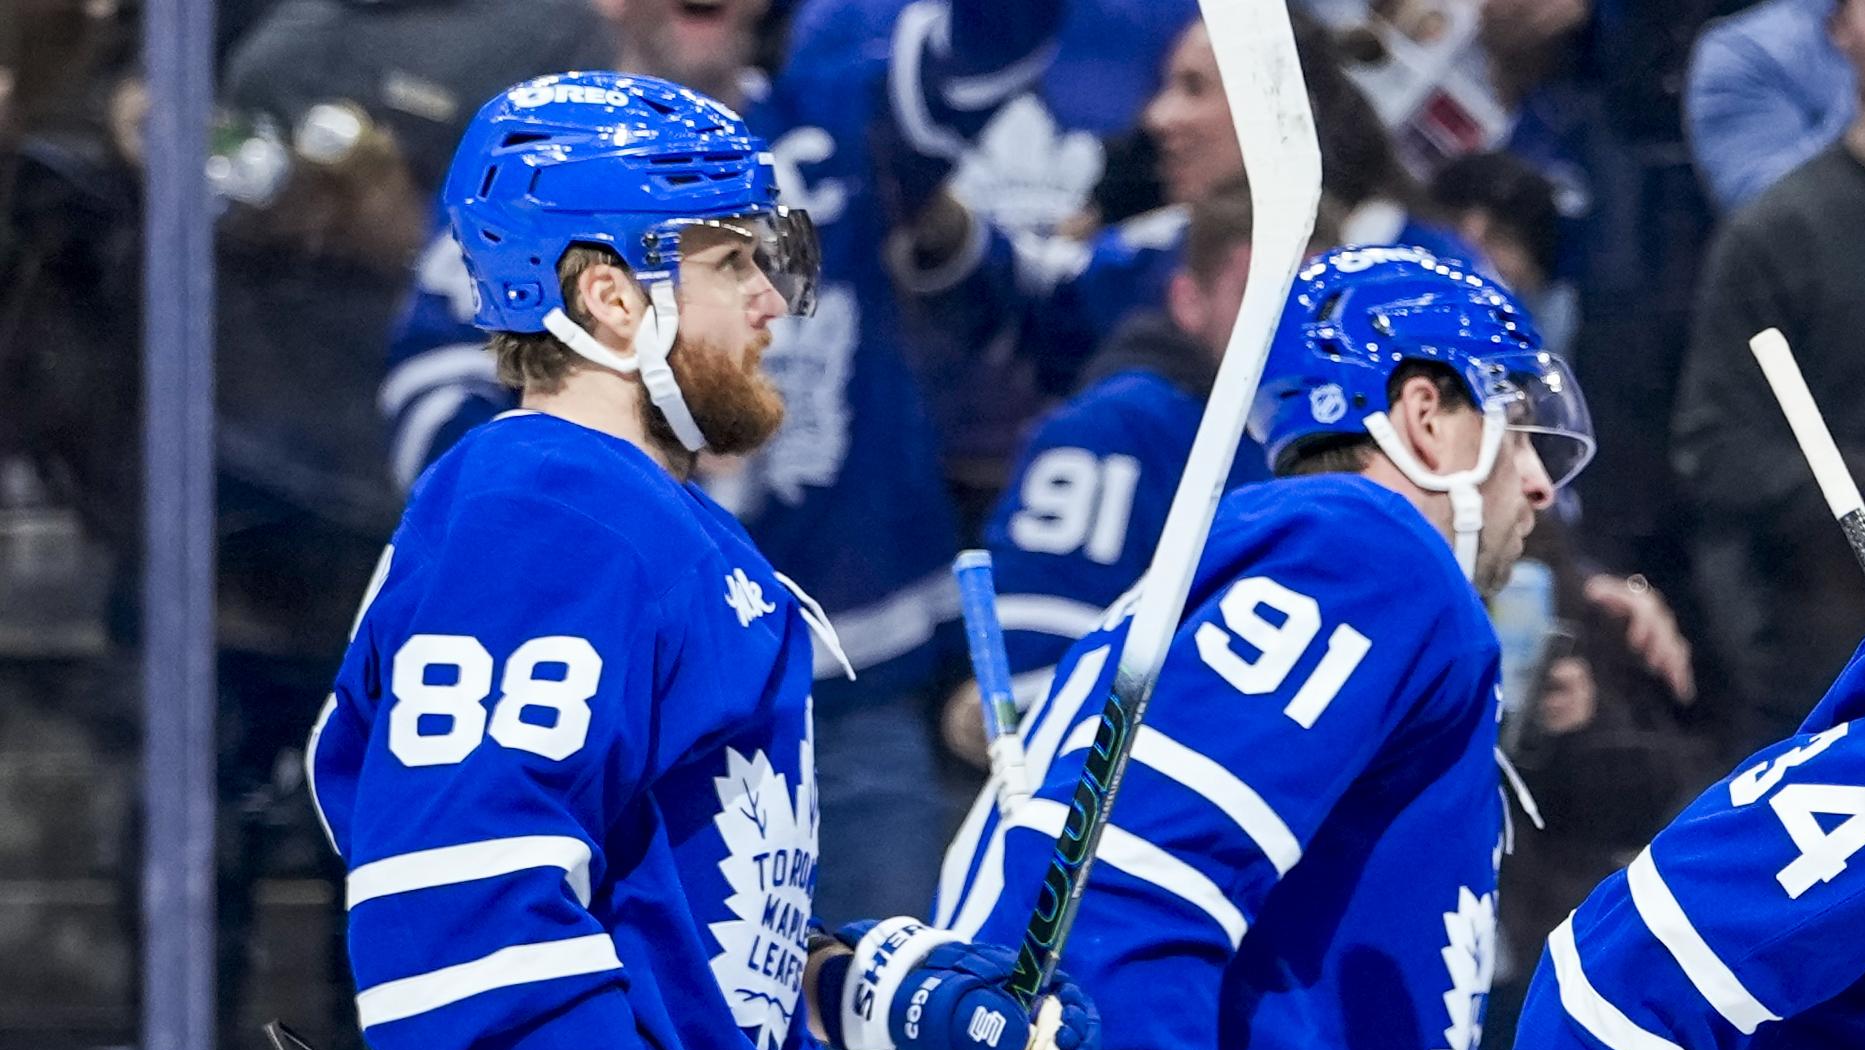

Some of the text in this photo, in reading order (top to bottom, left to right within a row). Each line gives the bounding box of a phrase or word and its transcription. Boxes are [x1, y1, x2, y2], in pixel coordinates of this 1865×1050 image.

[507, 84, 629, 108] OREO
[1006, 445, 1142, 566] 91
[389, 634, 603, 767] 88
[1194, 576, 1373, 730] 91
[747, 935, 803, 993] LEAFS
